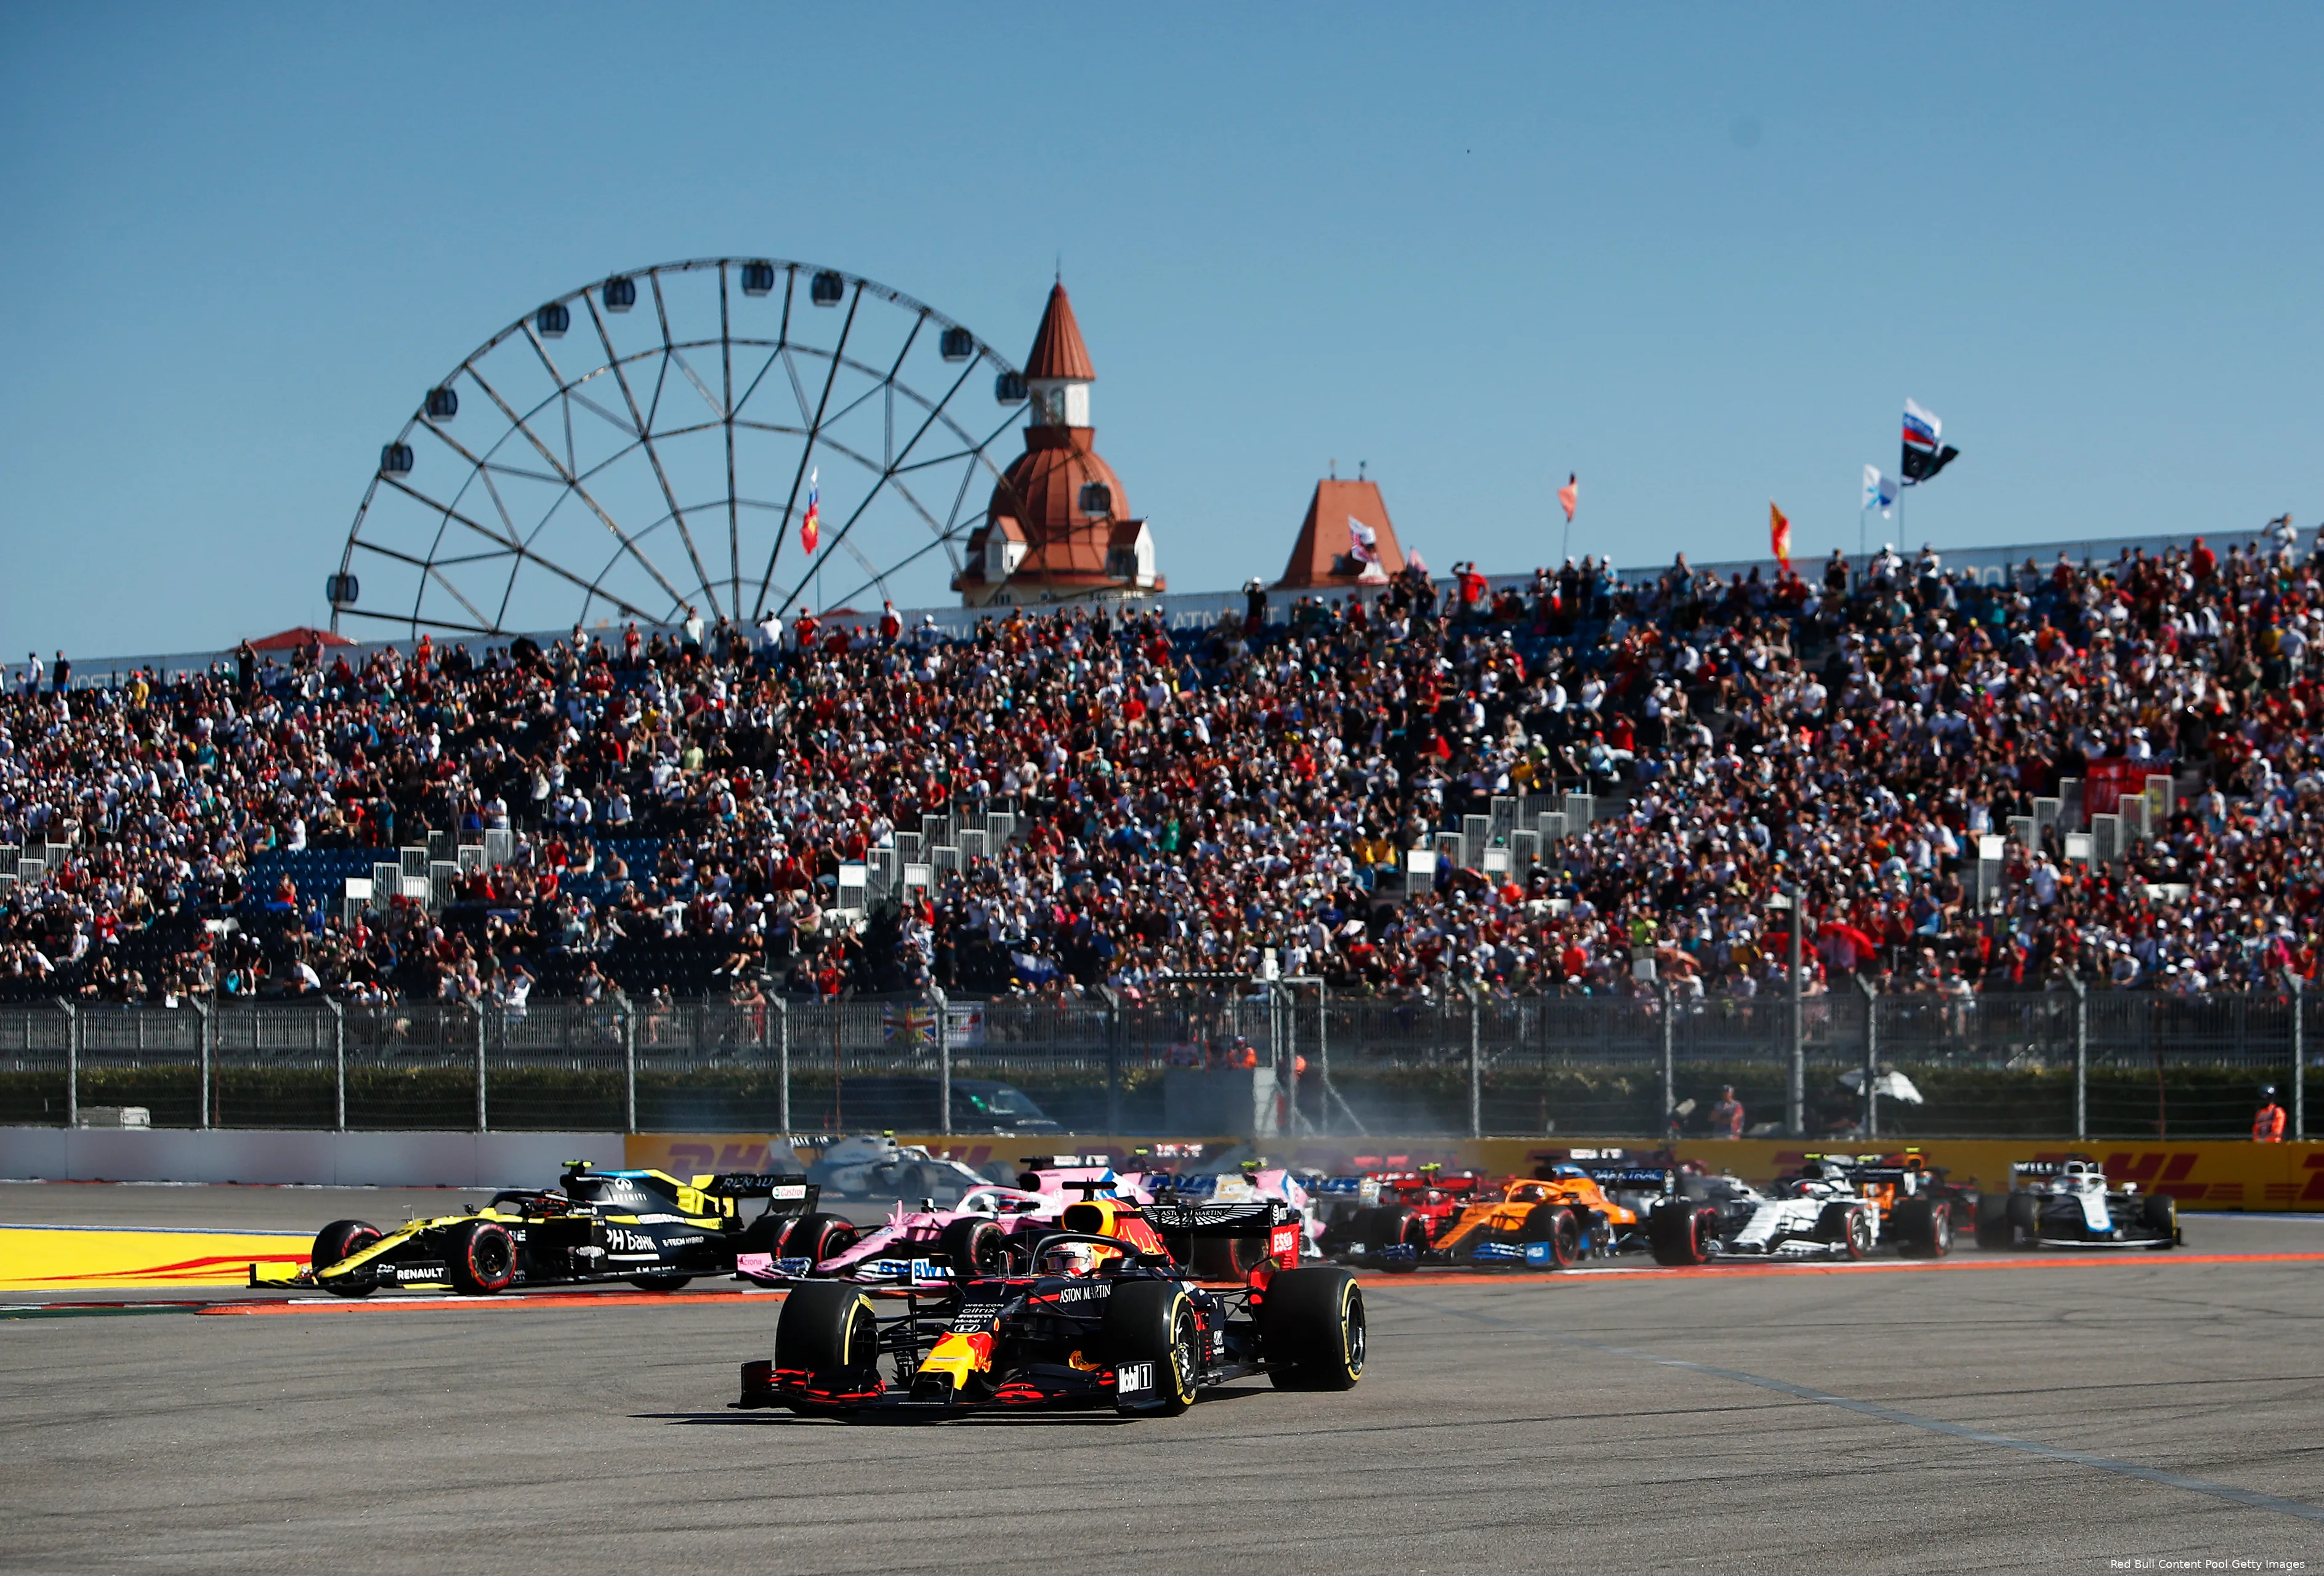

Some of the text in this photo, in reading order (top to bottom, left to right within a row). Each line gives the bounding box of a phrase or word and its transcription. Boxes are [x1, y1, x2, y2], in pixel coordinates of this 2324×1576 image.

[608, 1192, 647, 1202] INFINITI
[780, 1187, 803, 1197] Castrol
[676, 1186, 705, 1215] 31
[624, 1229, 657, 1251] Банк
[685, 1236, 704, 1244] HYBRID
[740, 1255, 762, 1265] Acronis
[397, 1267, 445, 1280] RENAULT
[1059, 1284, 1112, 1304] ASTON MARTIN
[1118, 1365, 1139, 1394] Mobil
